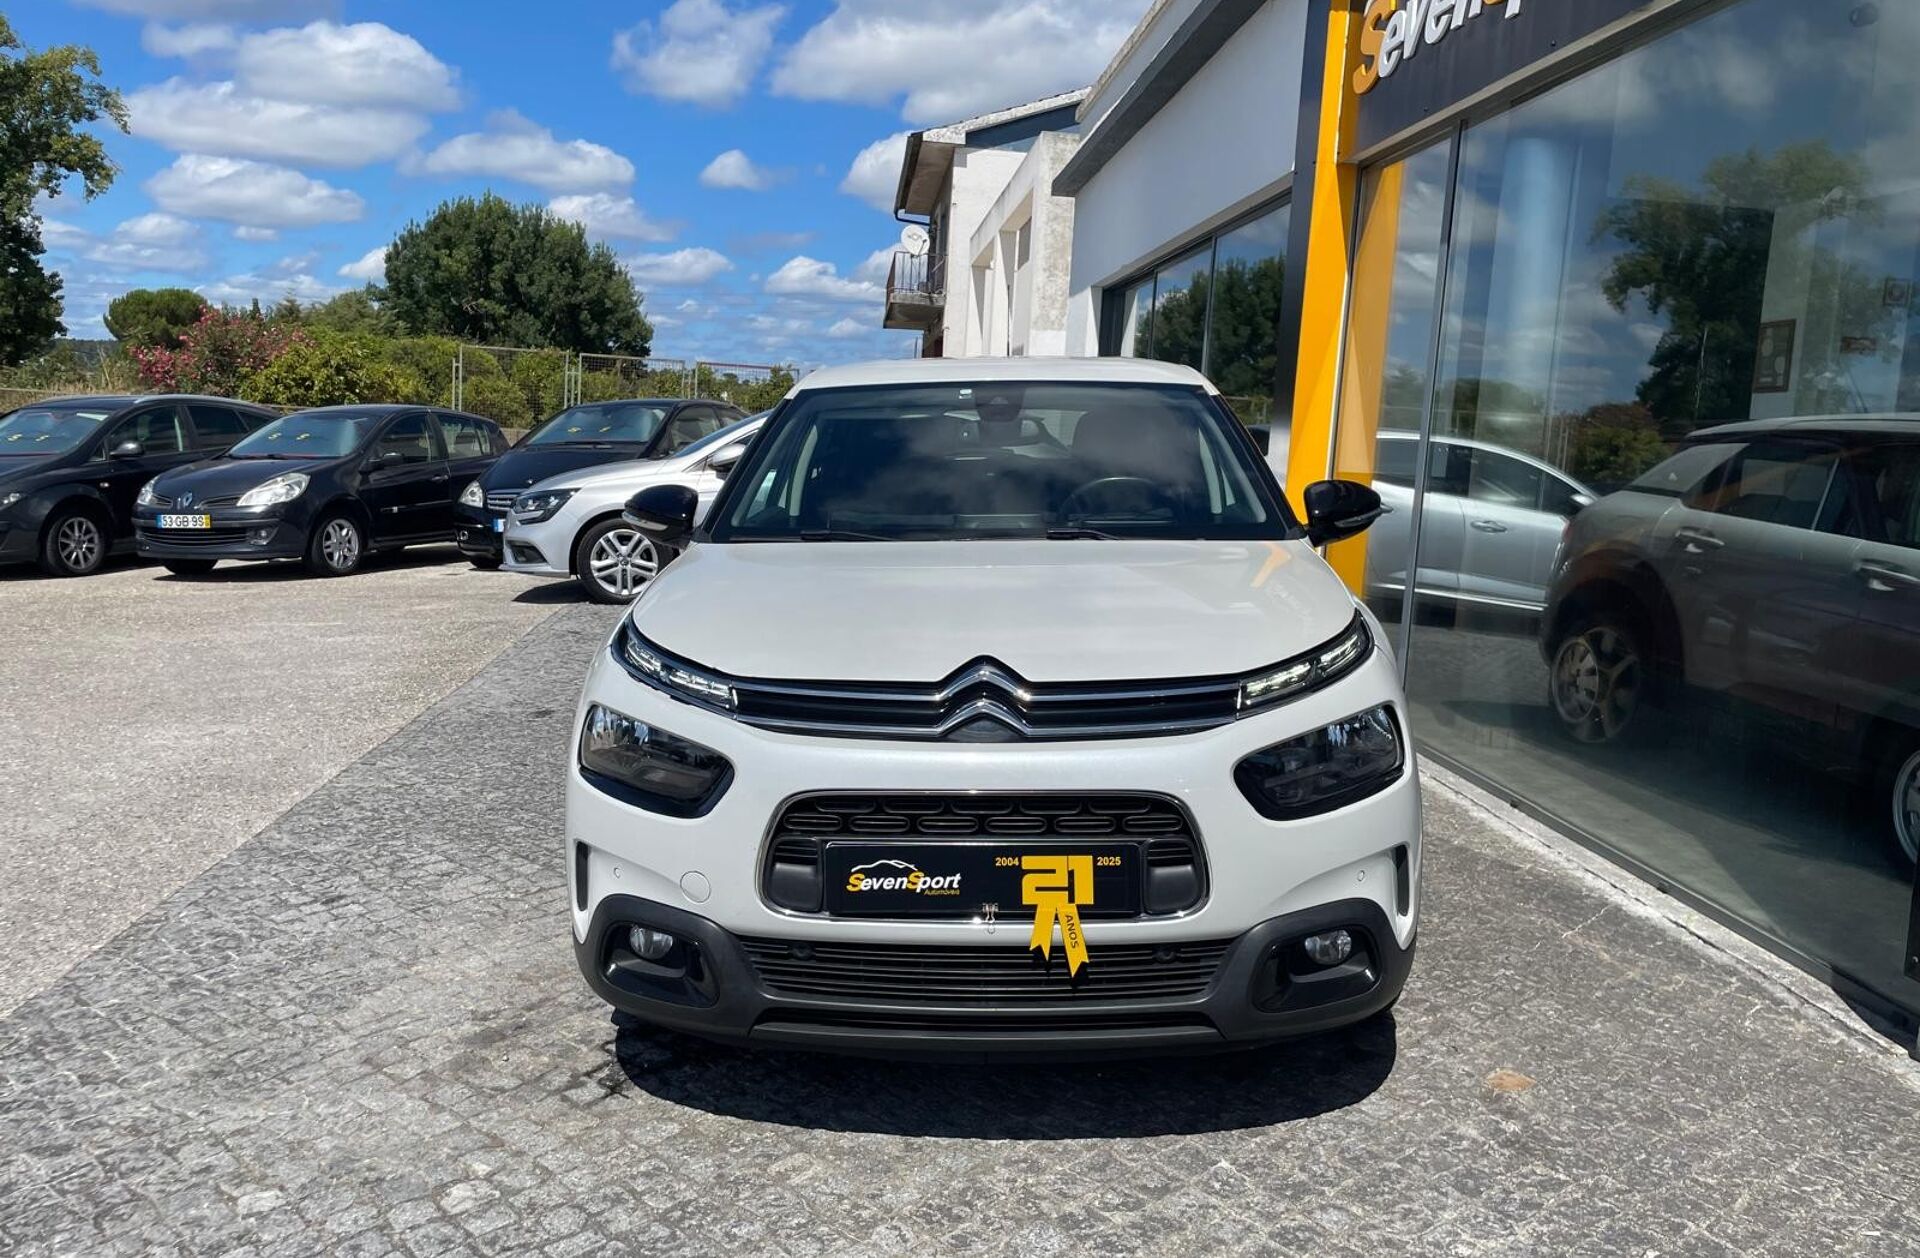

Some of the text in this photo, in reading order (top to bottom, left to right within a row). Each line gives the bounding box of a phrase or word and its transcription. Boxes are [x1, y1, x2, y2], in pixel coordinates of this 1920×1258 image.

[995, 857, 1019, 867] 2004
[1096, 856, 1122, 866] 2025
[846, 871, 961, 893] SevenSport
[1021, 855, 1094, 905] 21
[1065, 914, 1080, 949] ANOS
